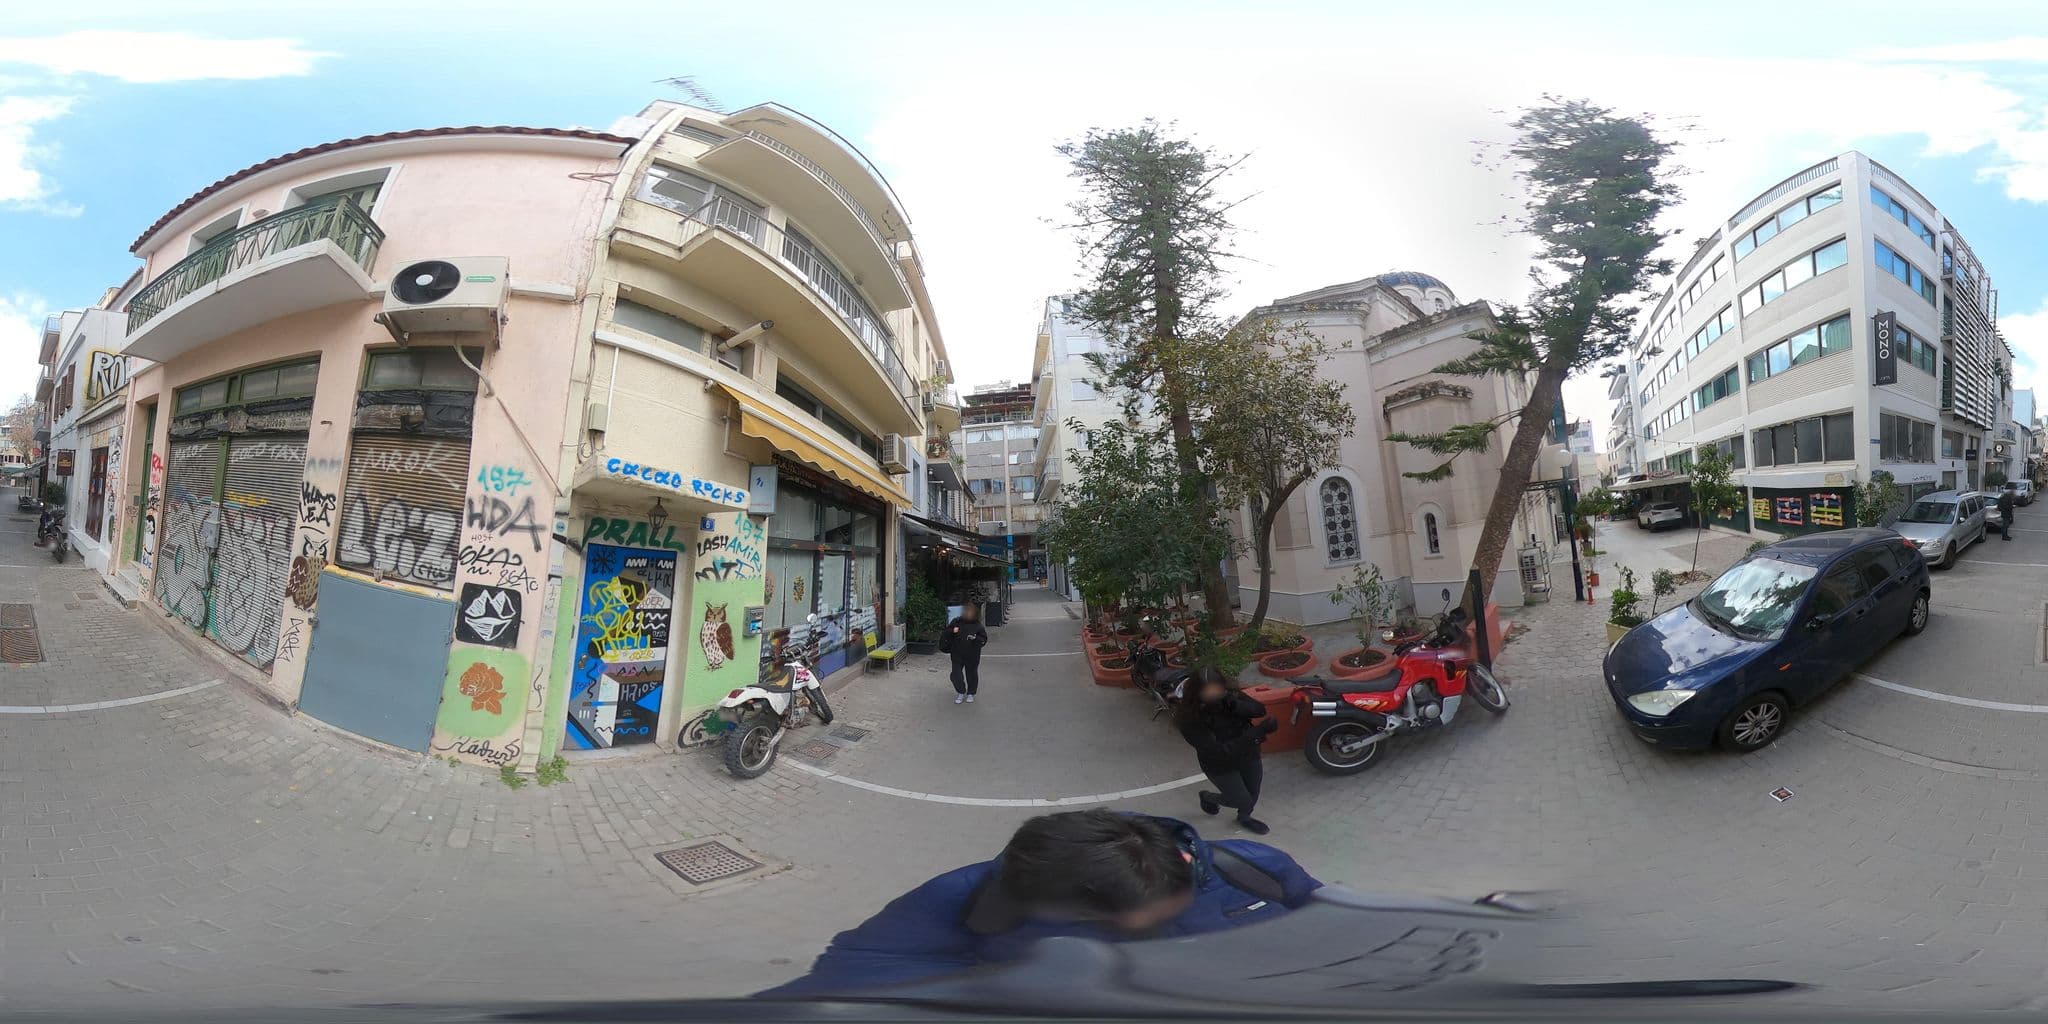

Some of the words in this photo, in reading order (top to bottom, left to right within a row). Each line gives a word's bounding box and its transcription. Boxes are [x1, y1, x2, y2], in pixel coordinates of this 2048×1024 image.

[1878, 320, 1890, 360] MONO
[466, 494, 548, 552] HDA
[580, 516, 686, 552] PRALL
[696, 535, 729, 557] LASH
